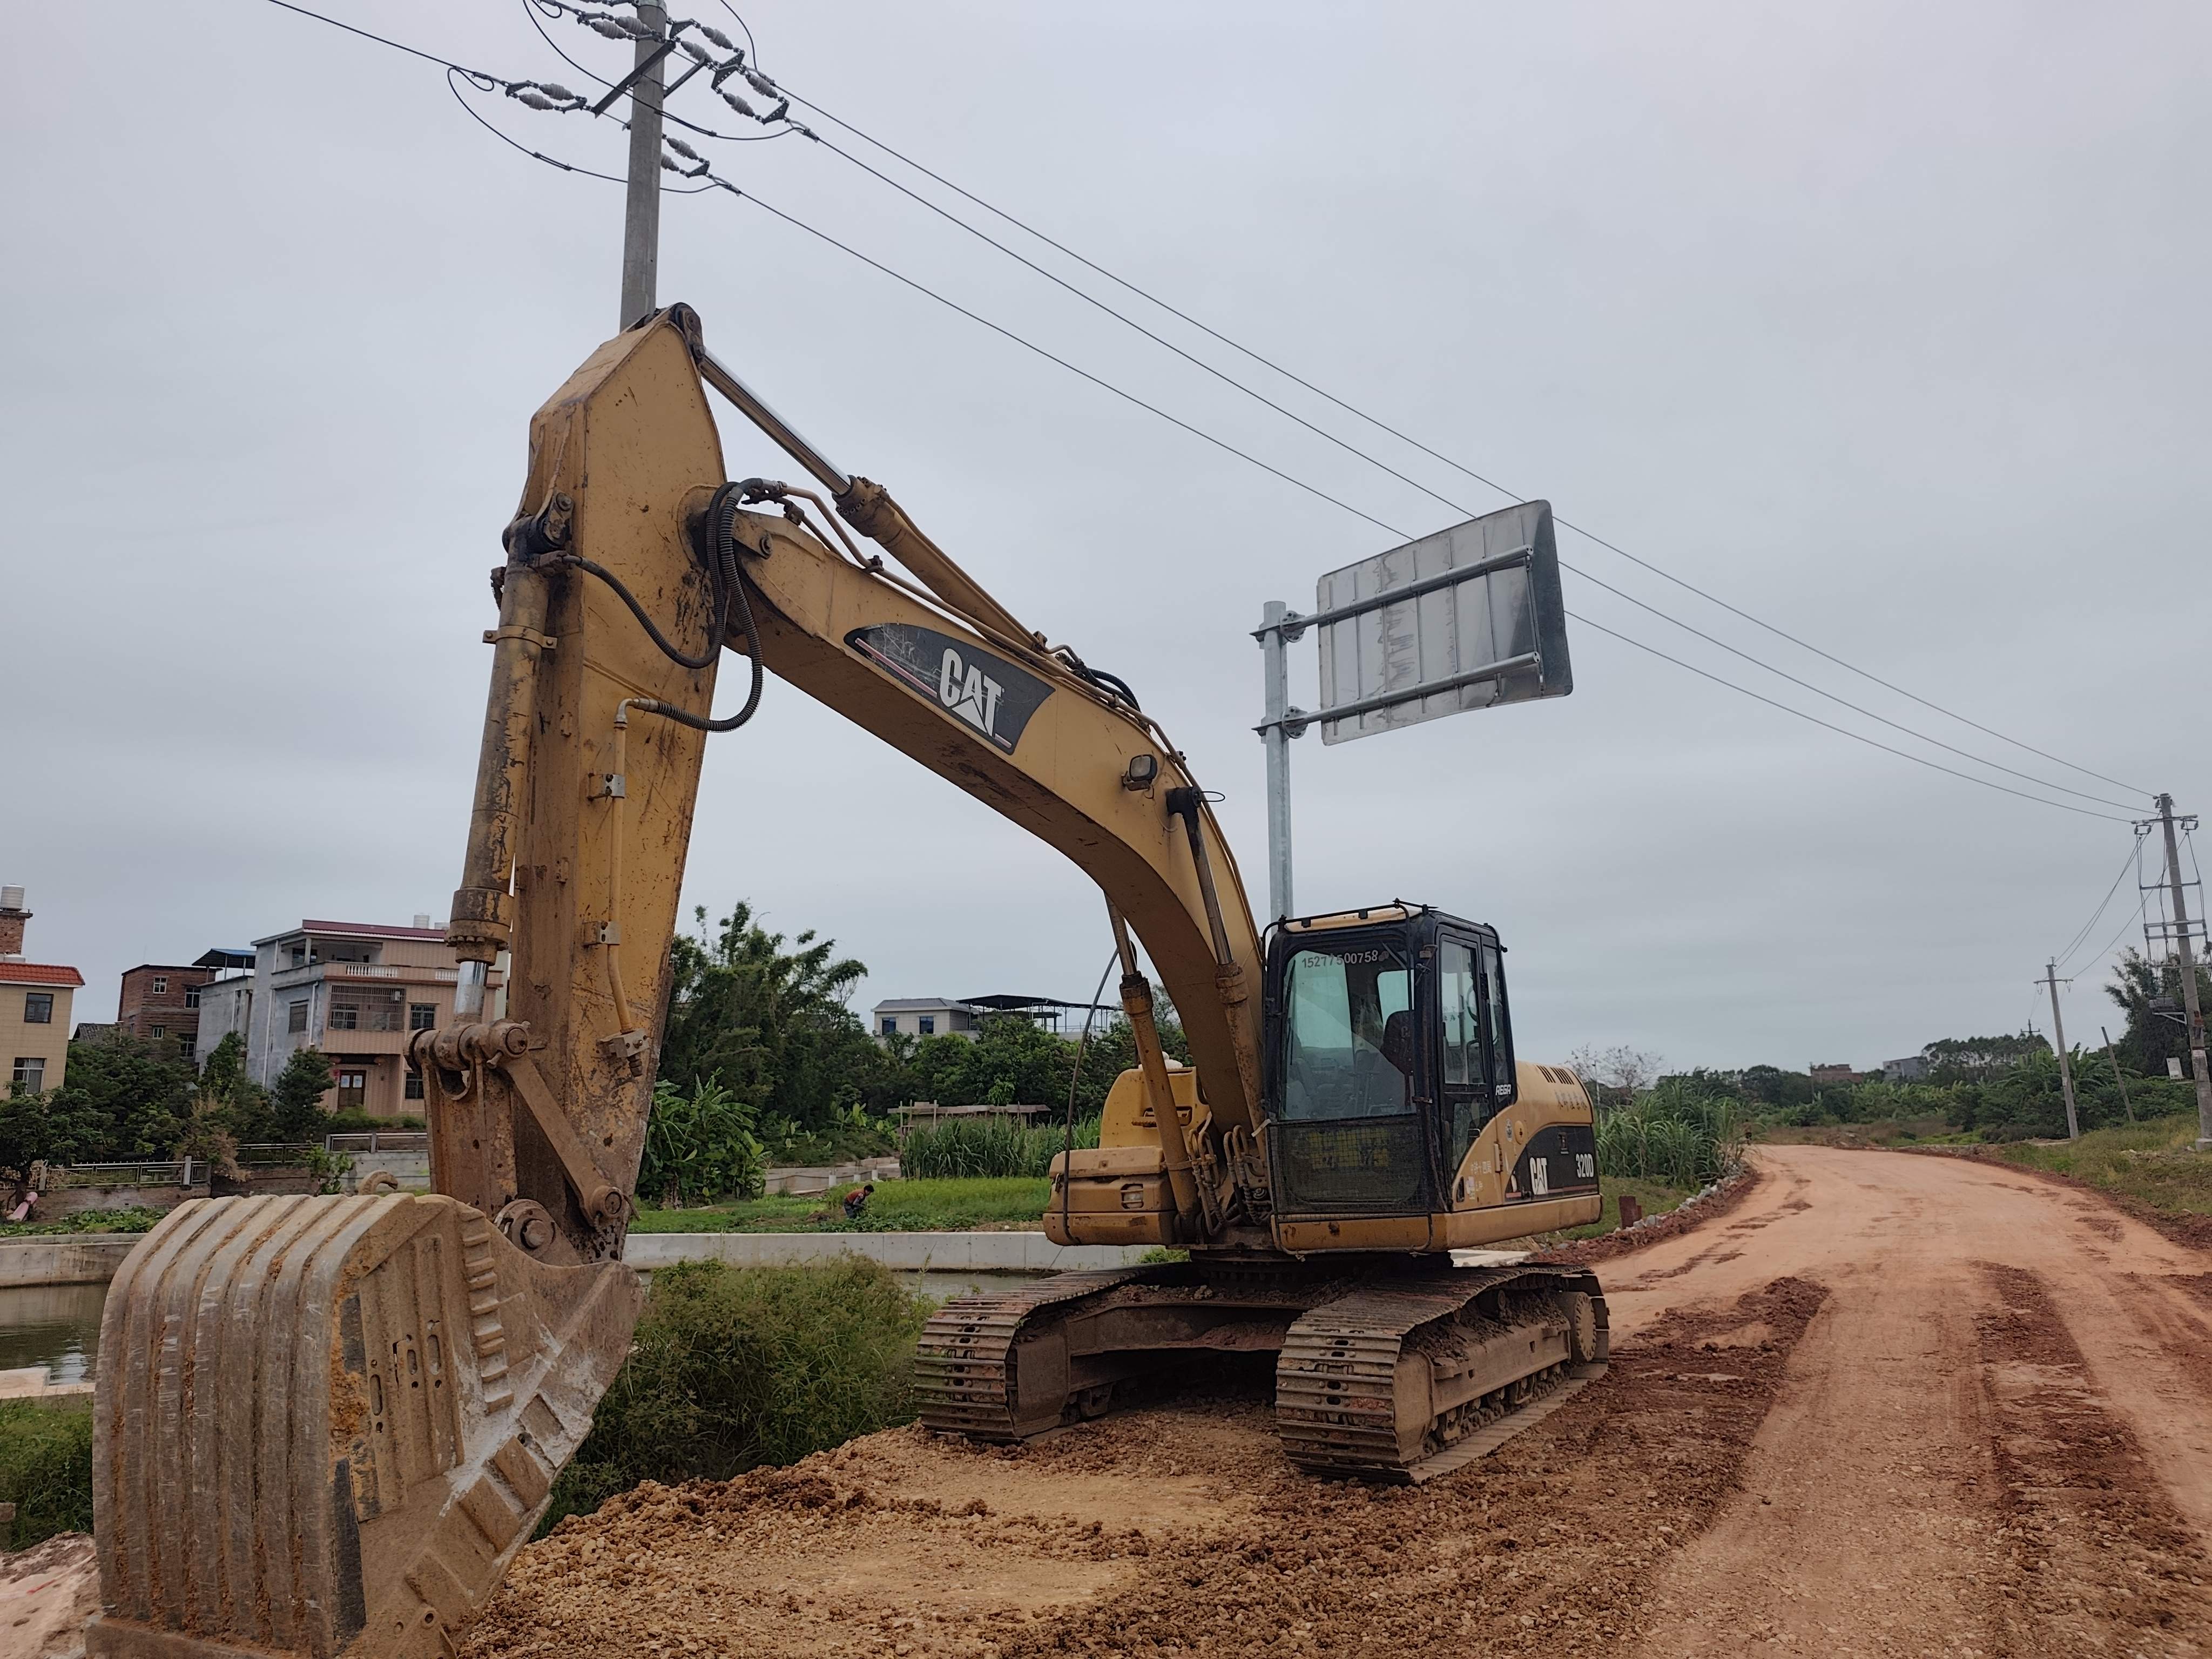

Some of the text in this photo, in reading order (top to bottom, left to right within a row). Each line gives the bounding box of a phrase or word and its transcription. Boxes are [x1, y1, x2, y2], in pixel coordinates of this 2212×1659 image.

[940, 648, 1002, 737] CAT
[1302, 950, 1378, 968] 15277500758
[1529, 1157, 1548, 1195] CAT
[1576, 1154, 1594, 1178] 320D
